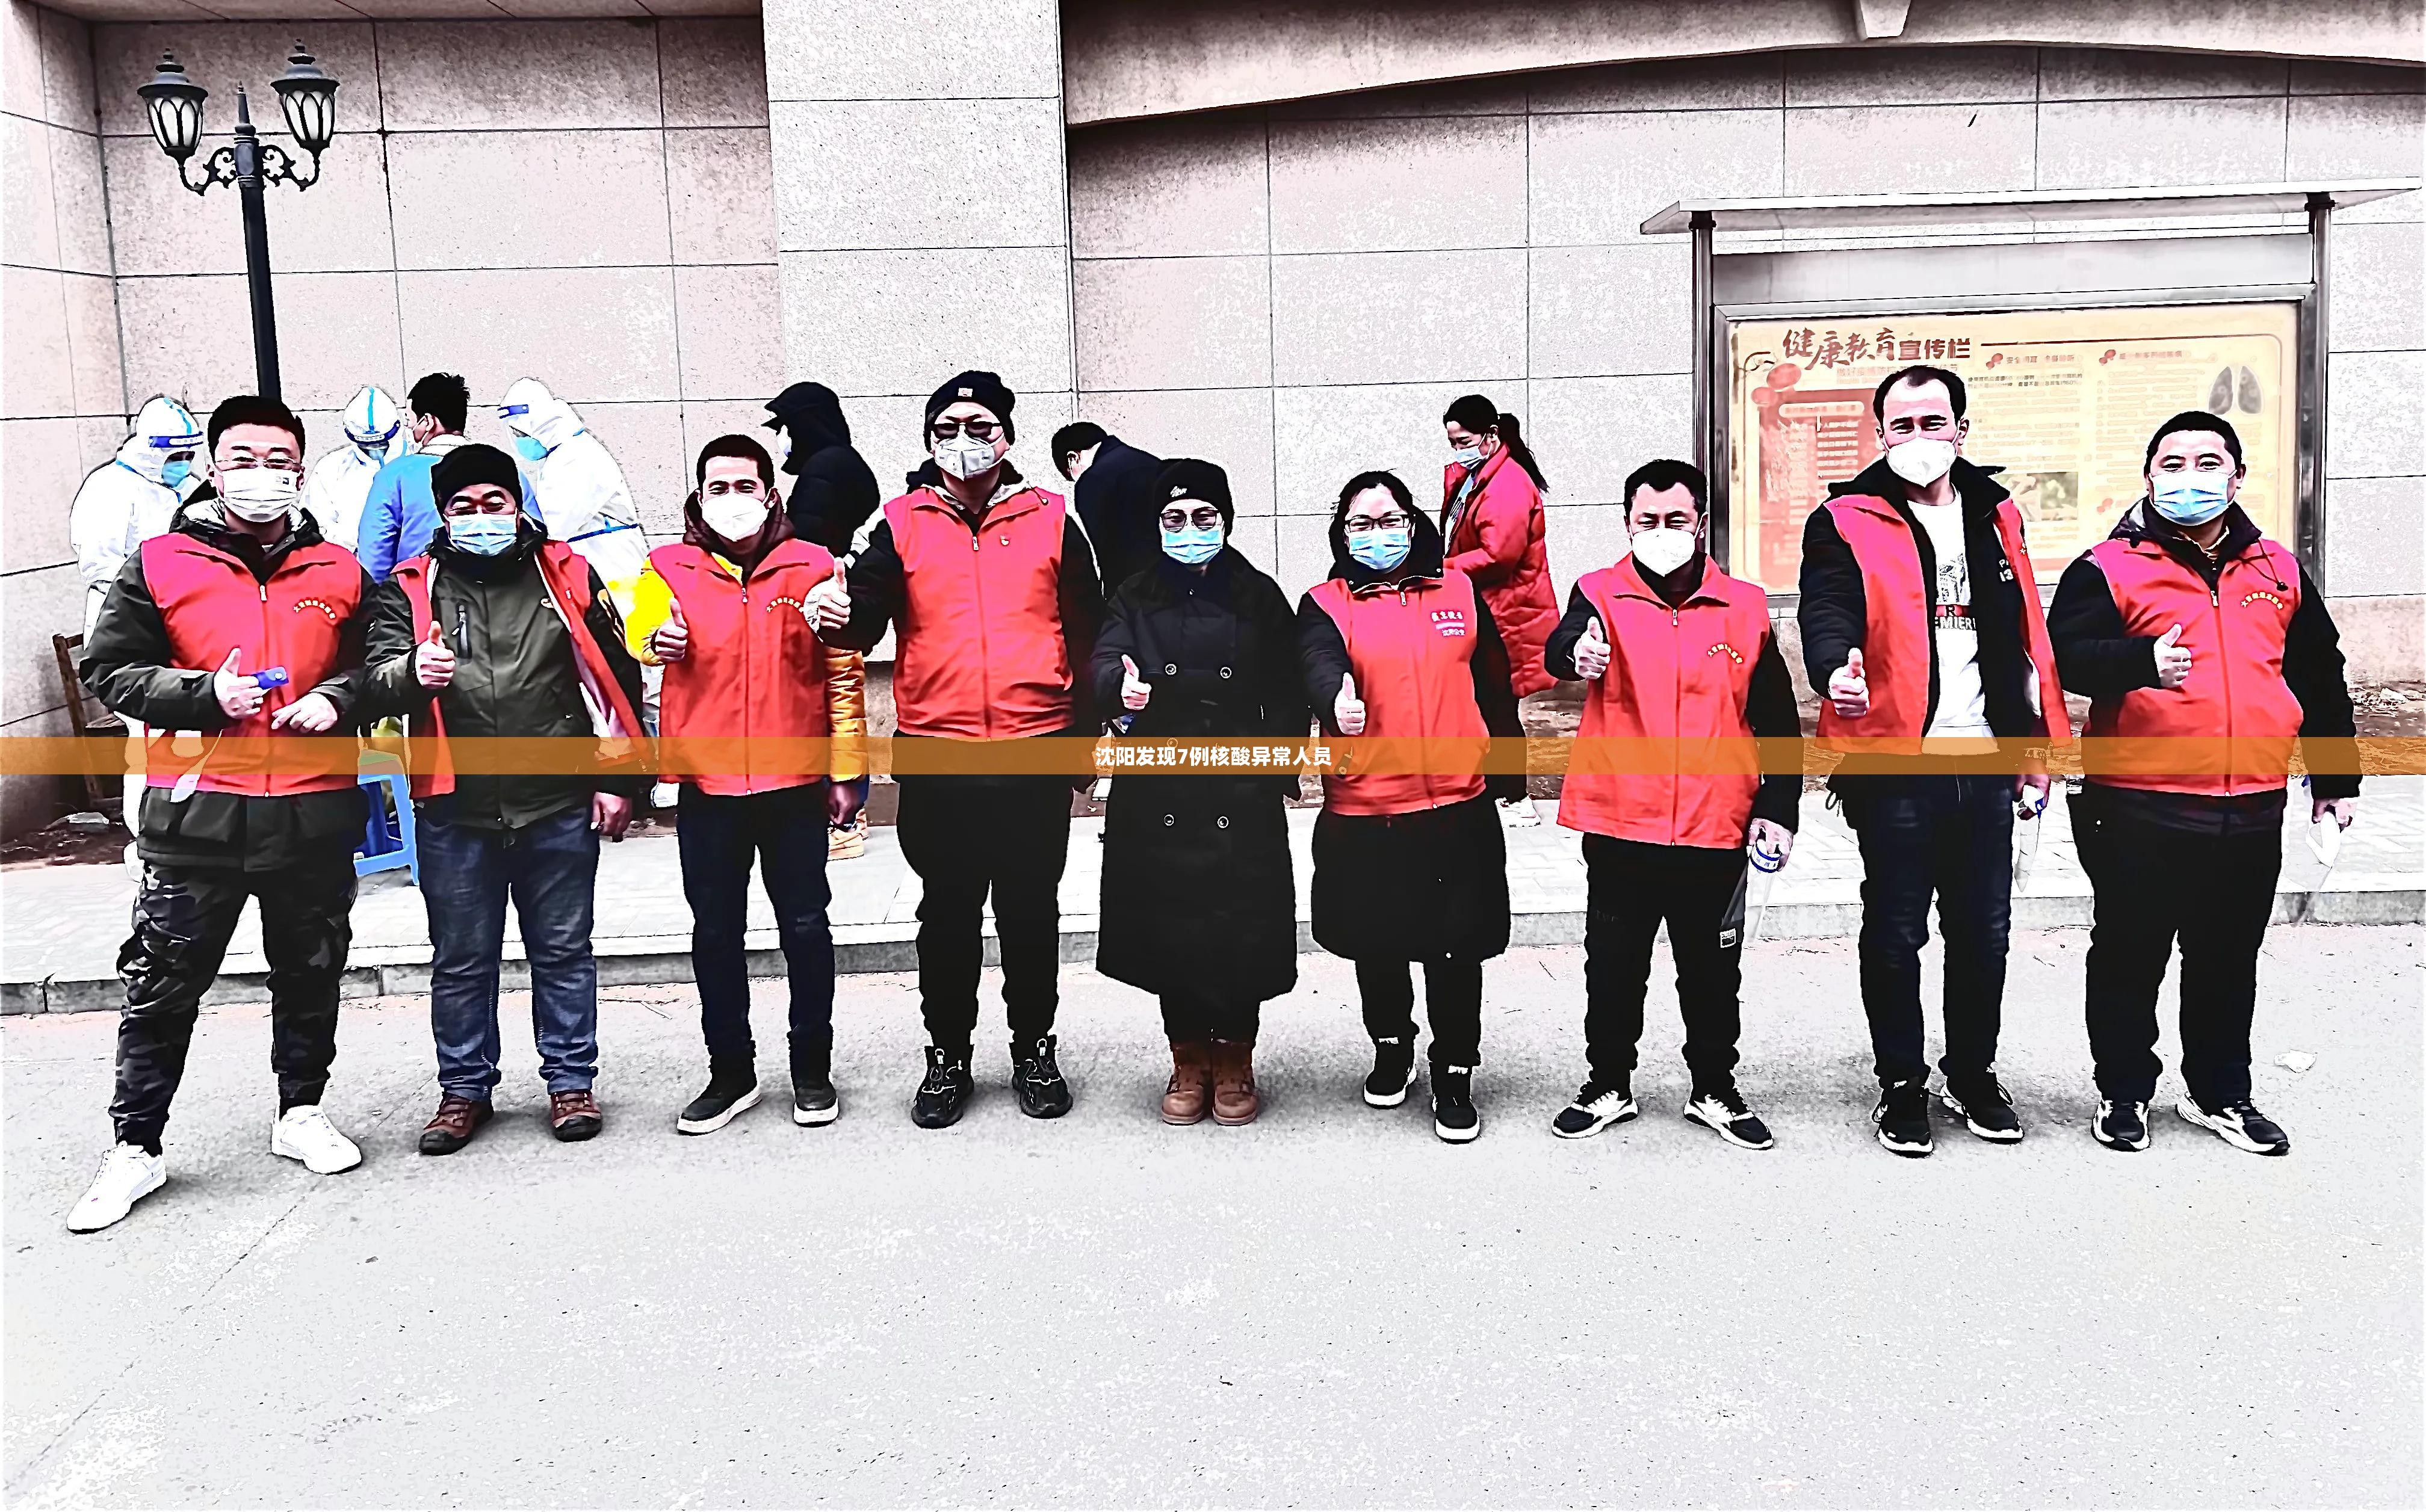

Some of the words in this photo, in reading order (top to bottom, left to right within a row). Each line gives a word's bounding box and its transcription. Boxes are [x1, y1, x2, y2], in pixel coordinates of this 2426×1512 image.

[1783, 327, 1970, 370] 健康教育宣传栏
